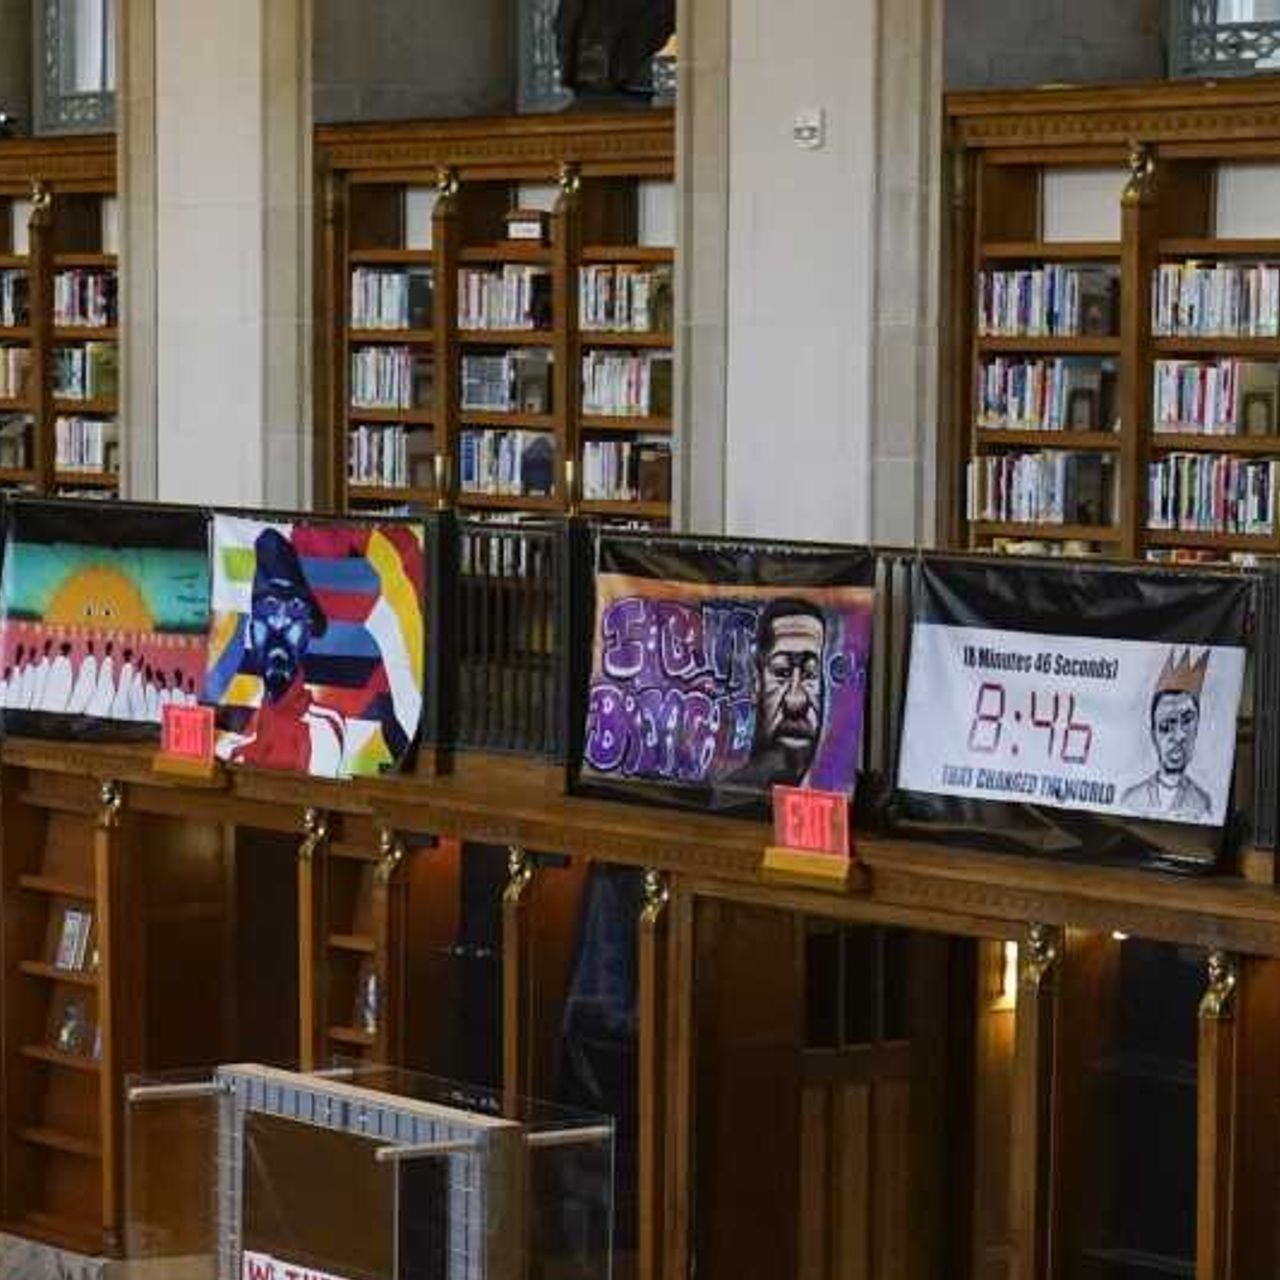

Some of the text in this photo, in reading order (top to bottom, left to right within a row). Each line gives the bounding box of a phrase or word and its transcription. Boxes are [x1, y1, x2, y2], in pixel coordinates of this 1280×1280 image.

[978, 648, 1032, 673] Minutes
[1034, 653, 1052, 674] 46
[969, 682, 1093, 765] 8:46
[975, 768, 1037, 793] CHANGED
[1063, 778, 1116, 804] WORLD
[784, 794, 833, 850] EXIT
